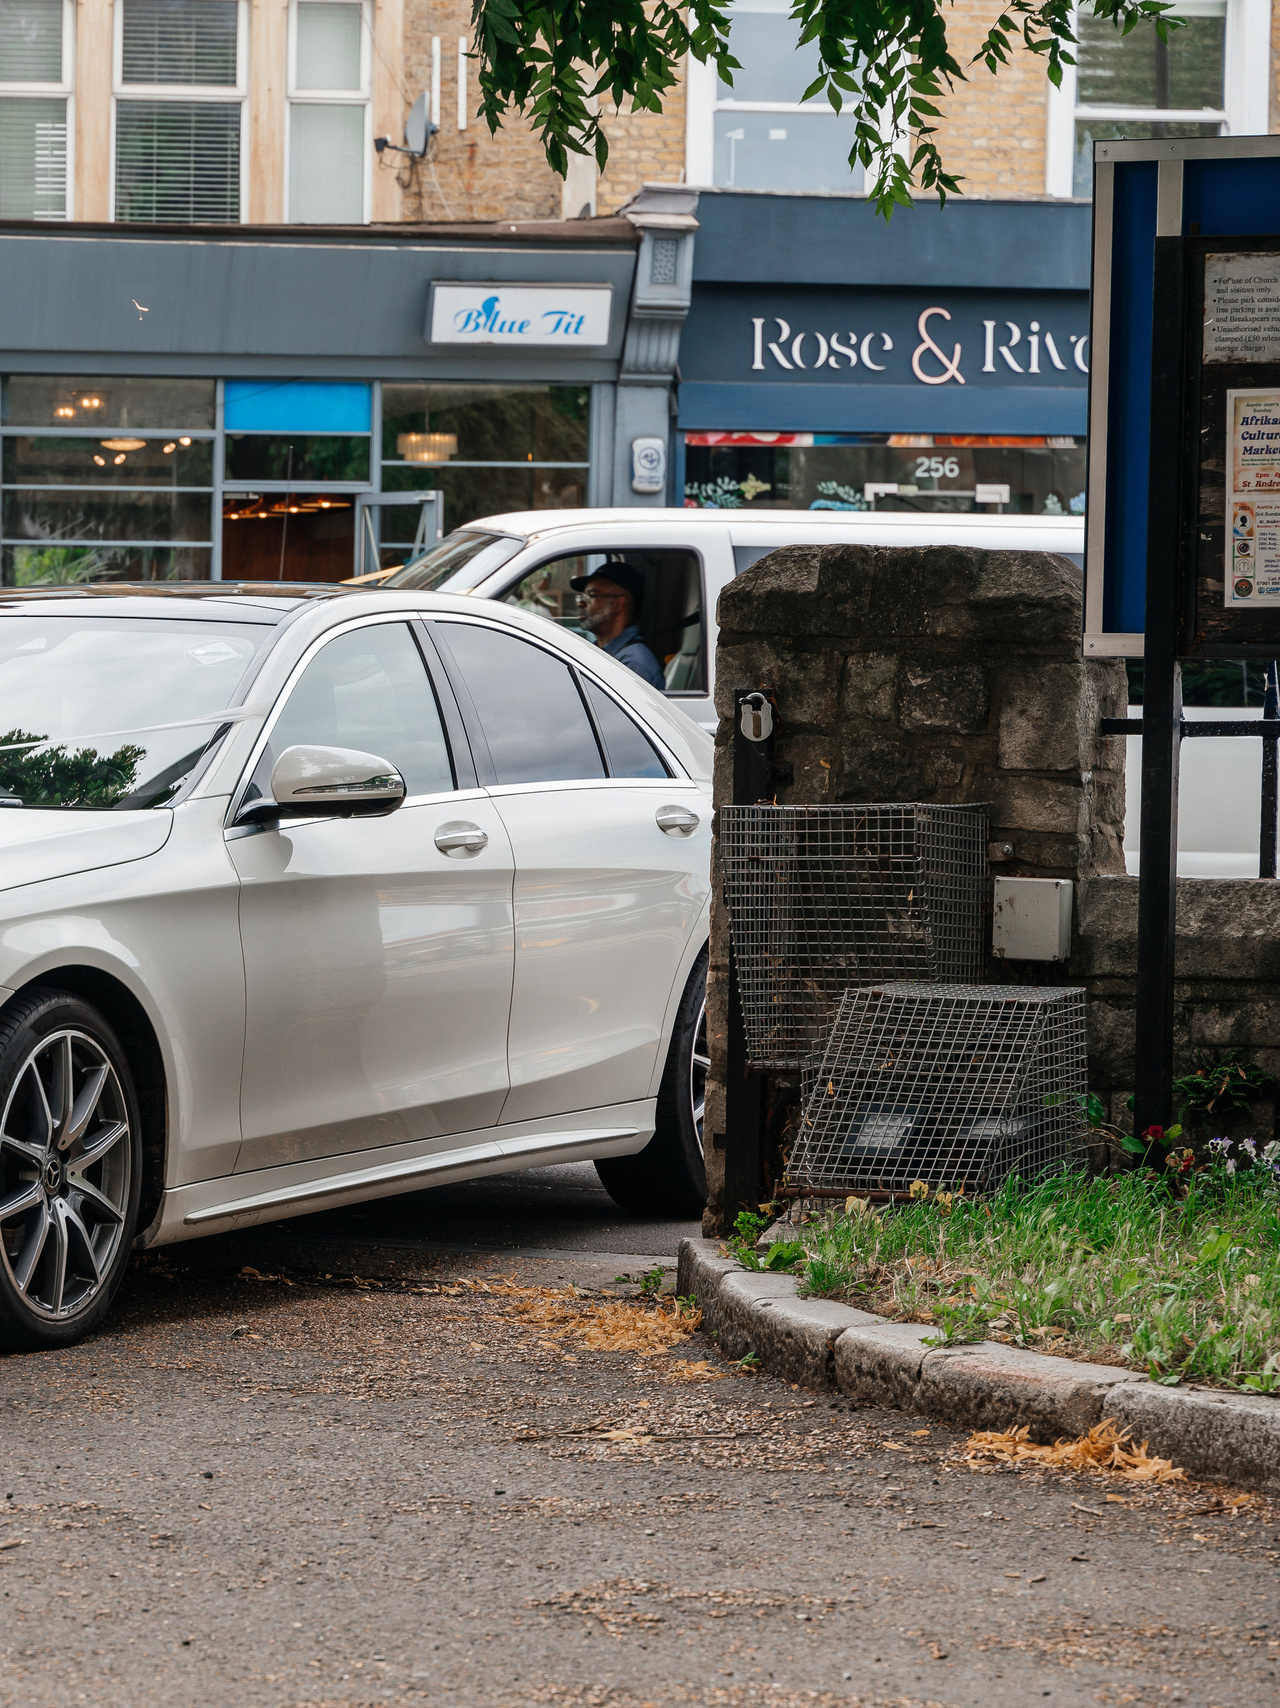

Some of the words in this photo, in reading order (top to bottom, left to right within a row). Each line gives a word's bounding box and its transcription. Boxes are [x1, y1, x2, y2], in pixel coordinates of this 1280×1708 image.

[1240, 296, 1255, 305] park
[1230, 305, 1256, 314] parking
[454, 301, 531, 334] Blue
[541, 310, 586, 335] Tit
[1230, 315, 1270, 323] Breakspears
[1217, 325, 1261, 333] Unauthorised
[1215, 335, 1243, 343] clamped
[1245, 334, 1261, 343] (£50
[750, 316, 894, 371] Rose
[911, 306, 966, 385] &
[1215, 345, 1238, 353] storage
[1241, 344, 1266, 352] charge)
[914, 456, 960, 479] 256
